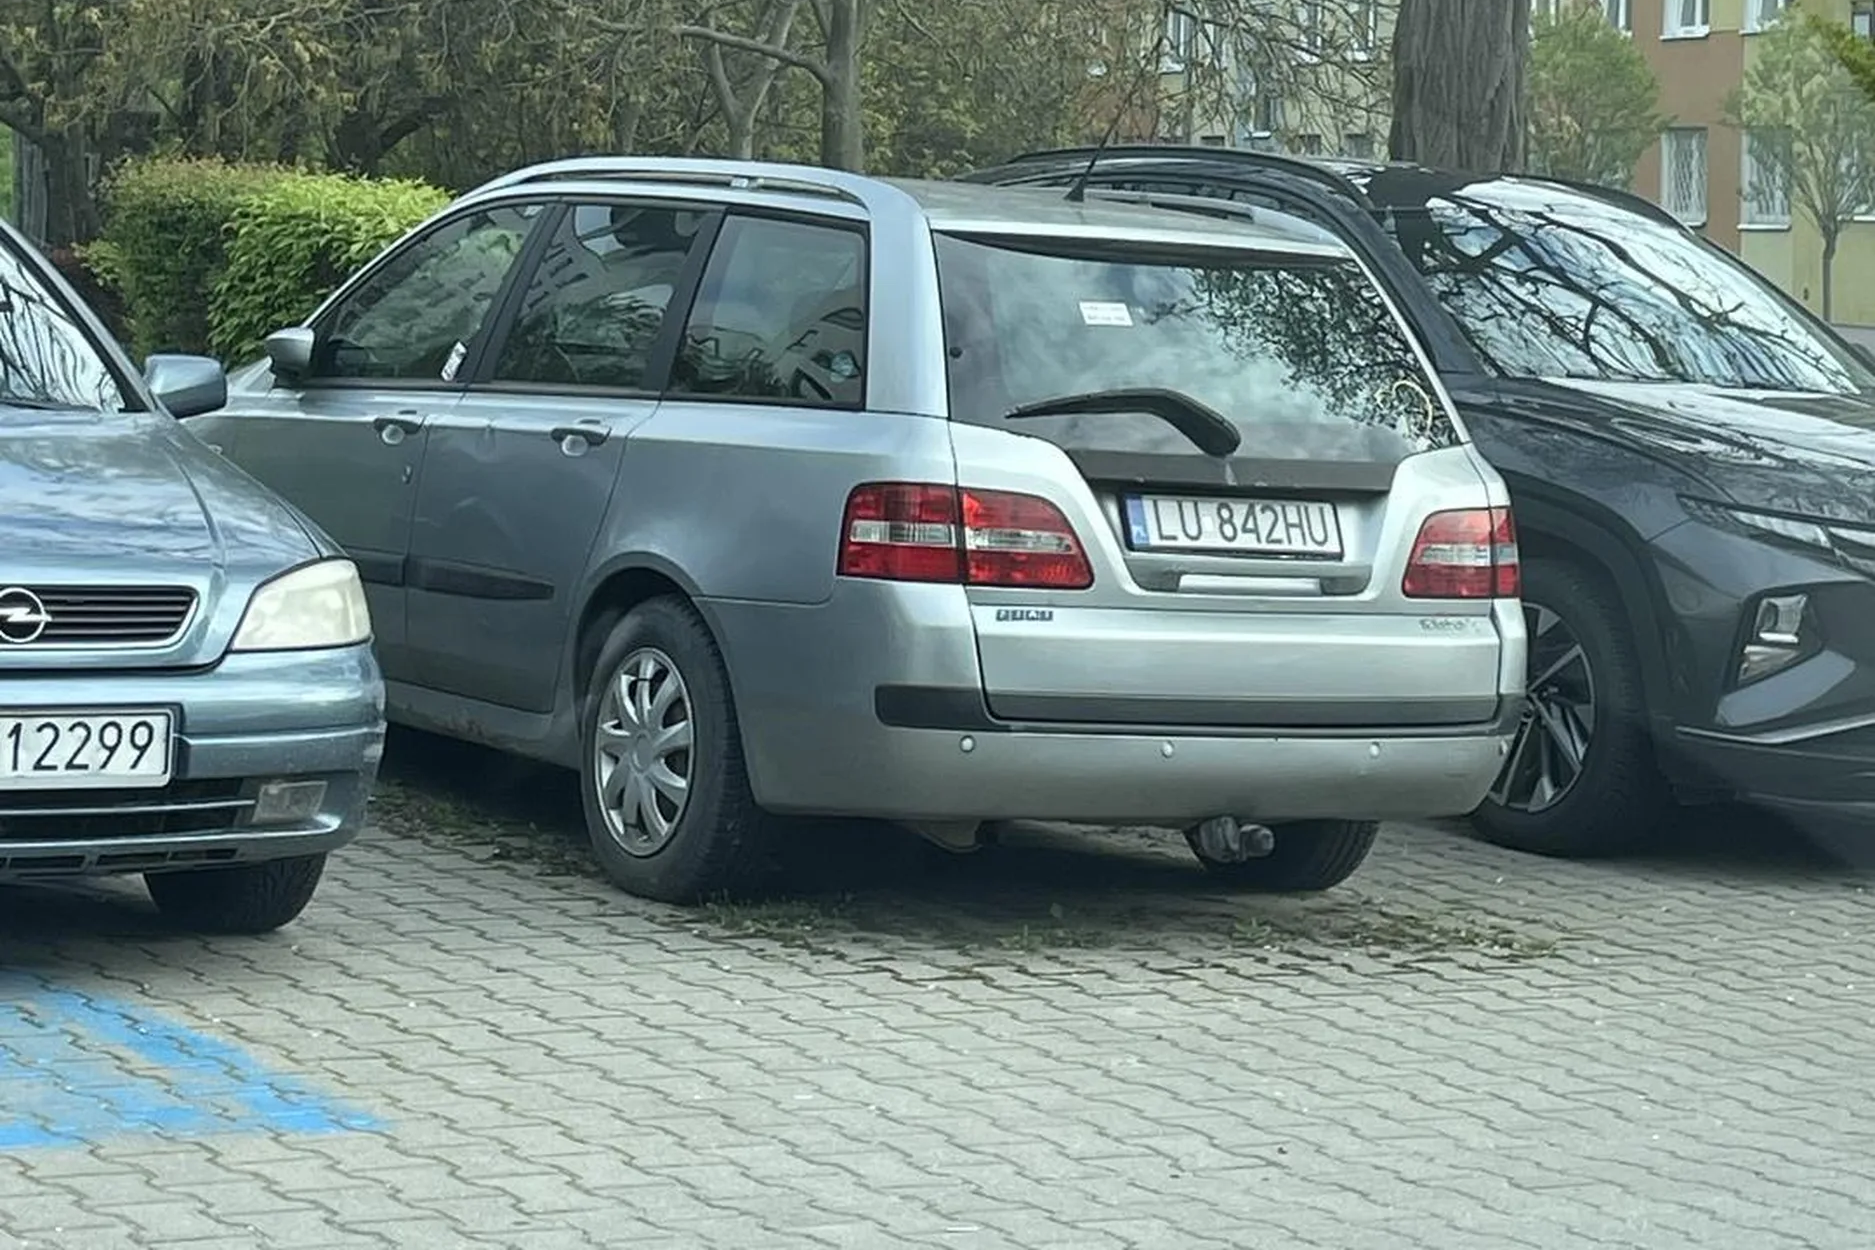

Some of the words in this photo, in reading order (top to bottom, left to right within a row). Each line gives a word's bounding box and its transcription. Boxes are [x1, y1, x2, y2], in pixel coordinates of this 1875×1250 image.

[1152, 500, 1202, 541] LU
[1216, 502, 1328, 546] 842HU
[7, 720, 154, 771] 12299
